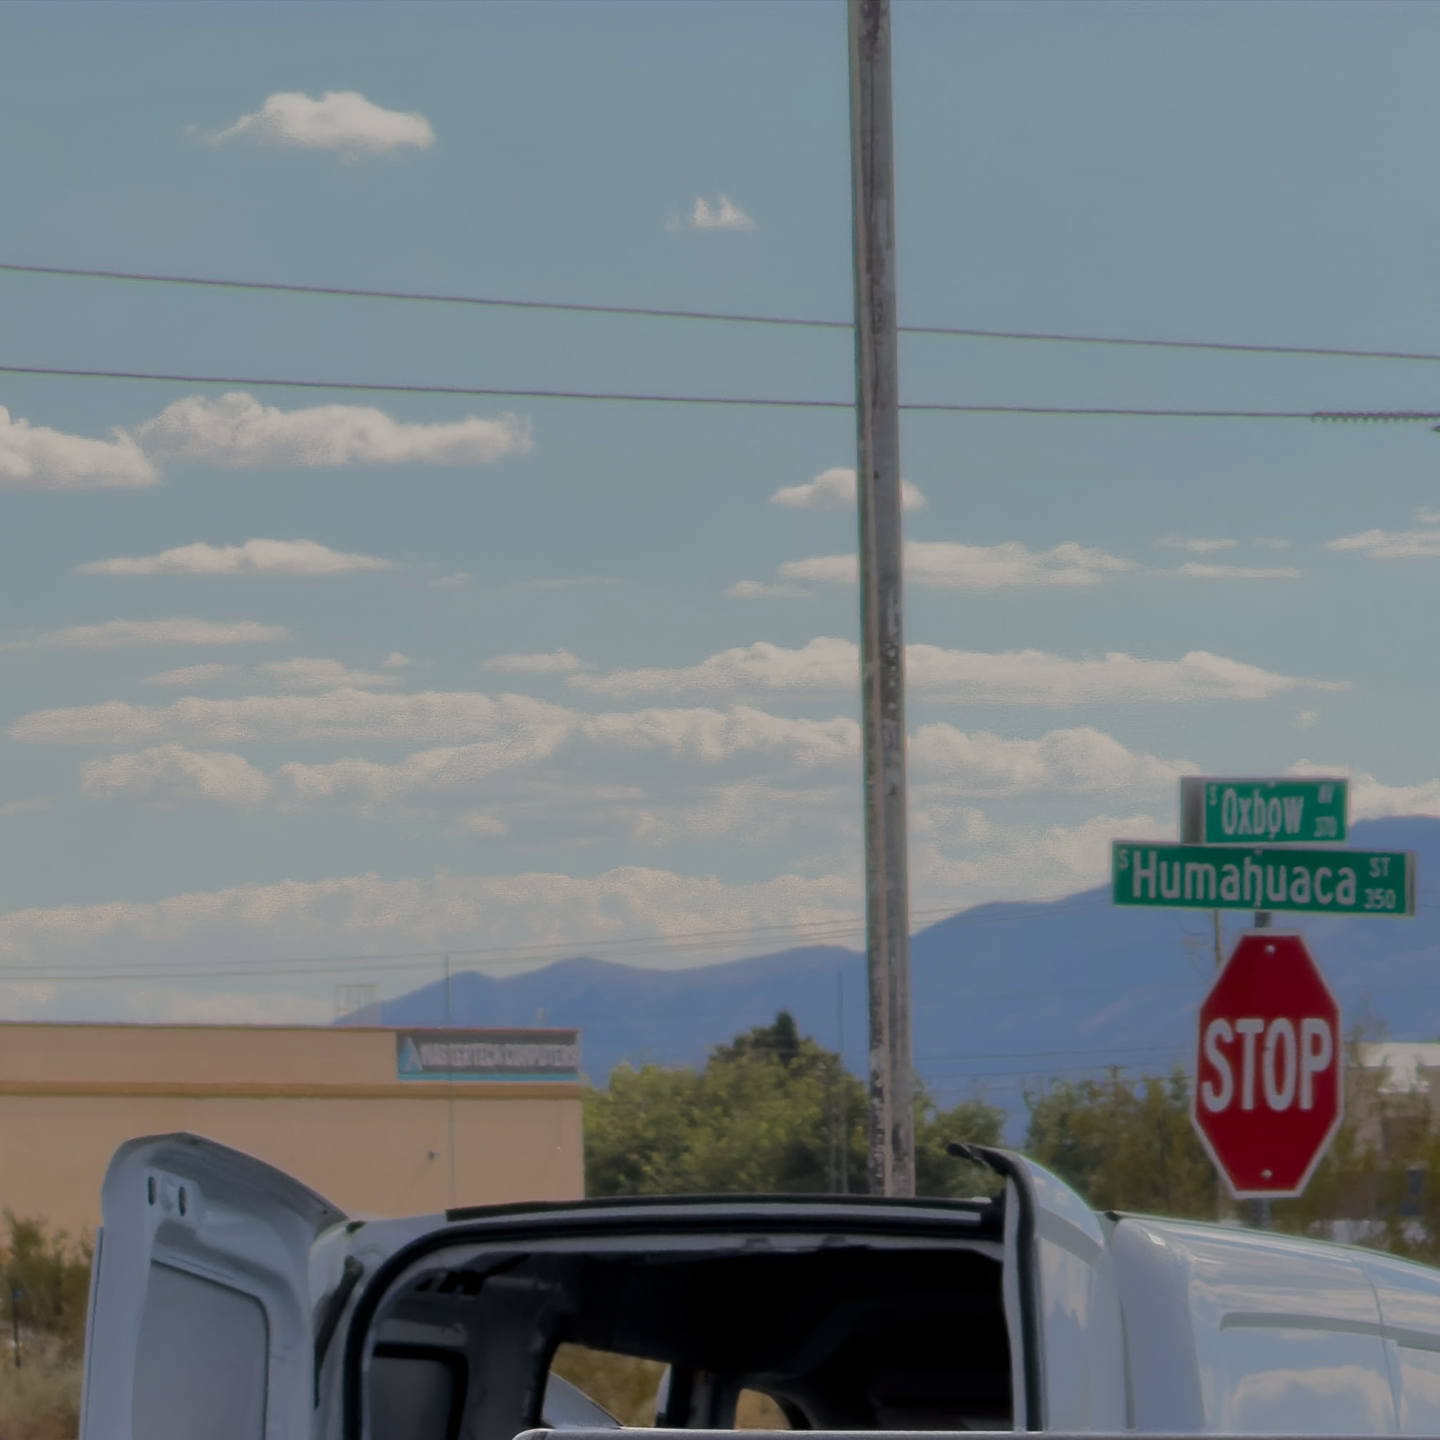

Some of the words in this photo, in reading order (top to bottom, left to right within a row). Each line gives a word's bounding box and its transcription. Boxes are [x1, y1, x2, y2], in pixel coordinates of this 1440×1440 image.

[1221, 787, 1304, 836] Oxbow
[1118, 849, 1129, 870] S
[1132, 849, 1357, 906] Humahuaca
[1368, 856, 1391, 878] ST
[1364, 888, 1397, 910] 350
[1201, 1017, 1334, 1114] STOP
